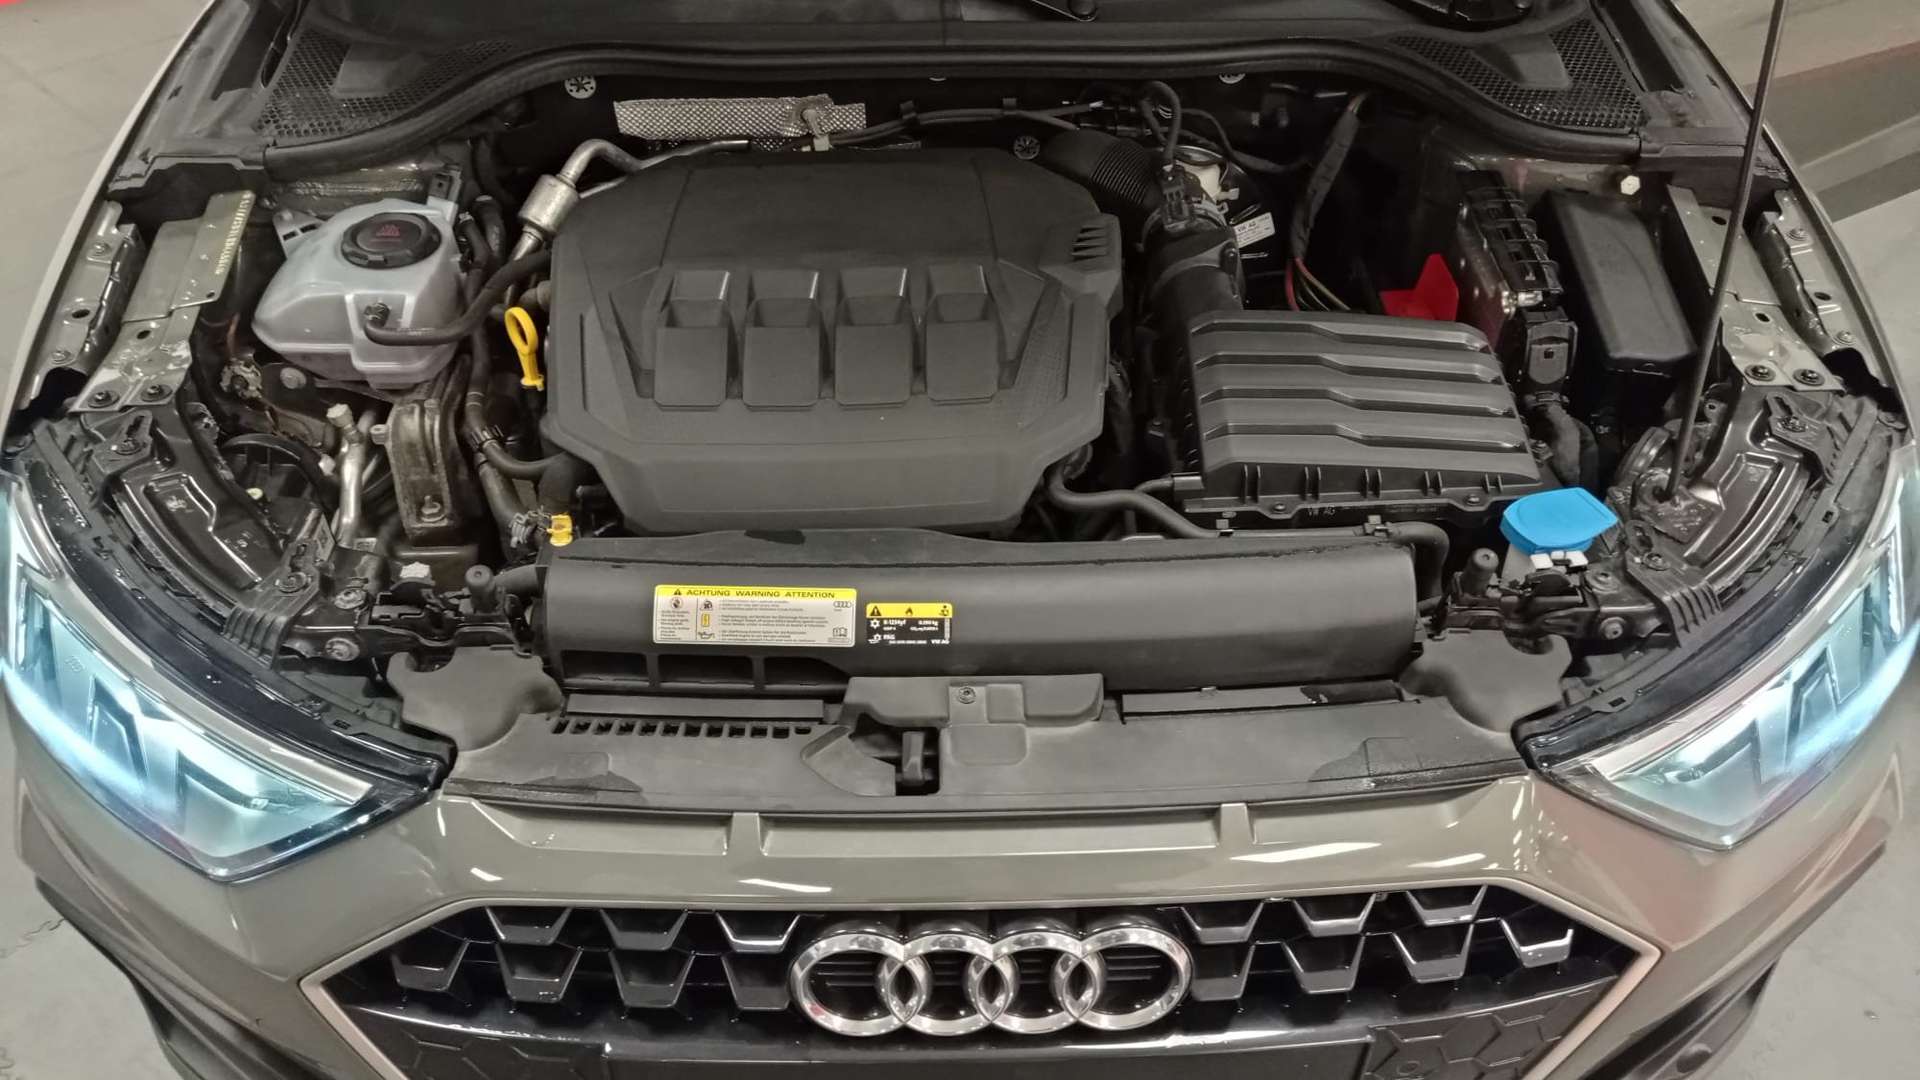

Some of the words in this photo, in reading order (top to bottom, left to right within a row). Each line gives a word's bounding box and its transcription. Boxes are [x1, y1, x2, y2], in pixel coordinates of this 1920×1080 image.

[686, 589, 731, 597] ACHTUNG
[735, 590, 780, 598] WARNING
[785, 591, 835, 599] ATTENTION
